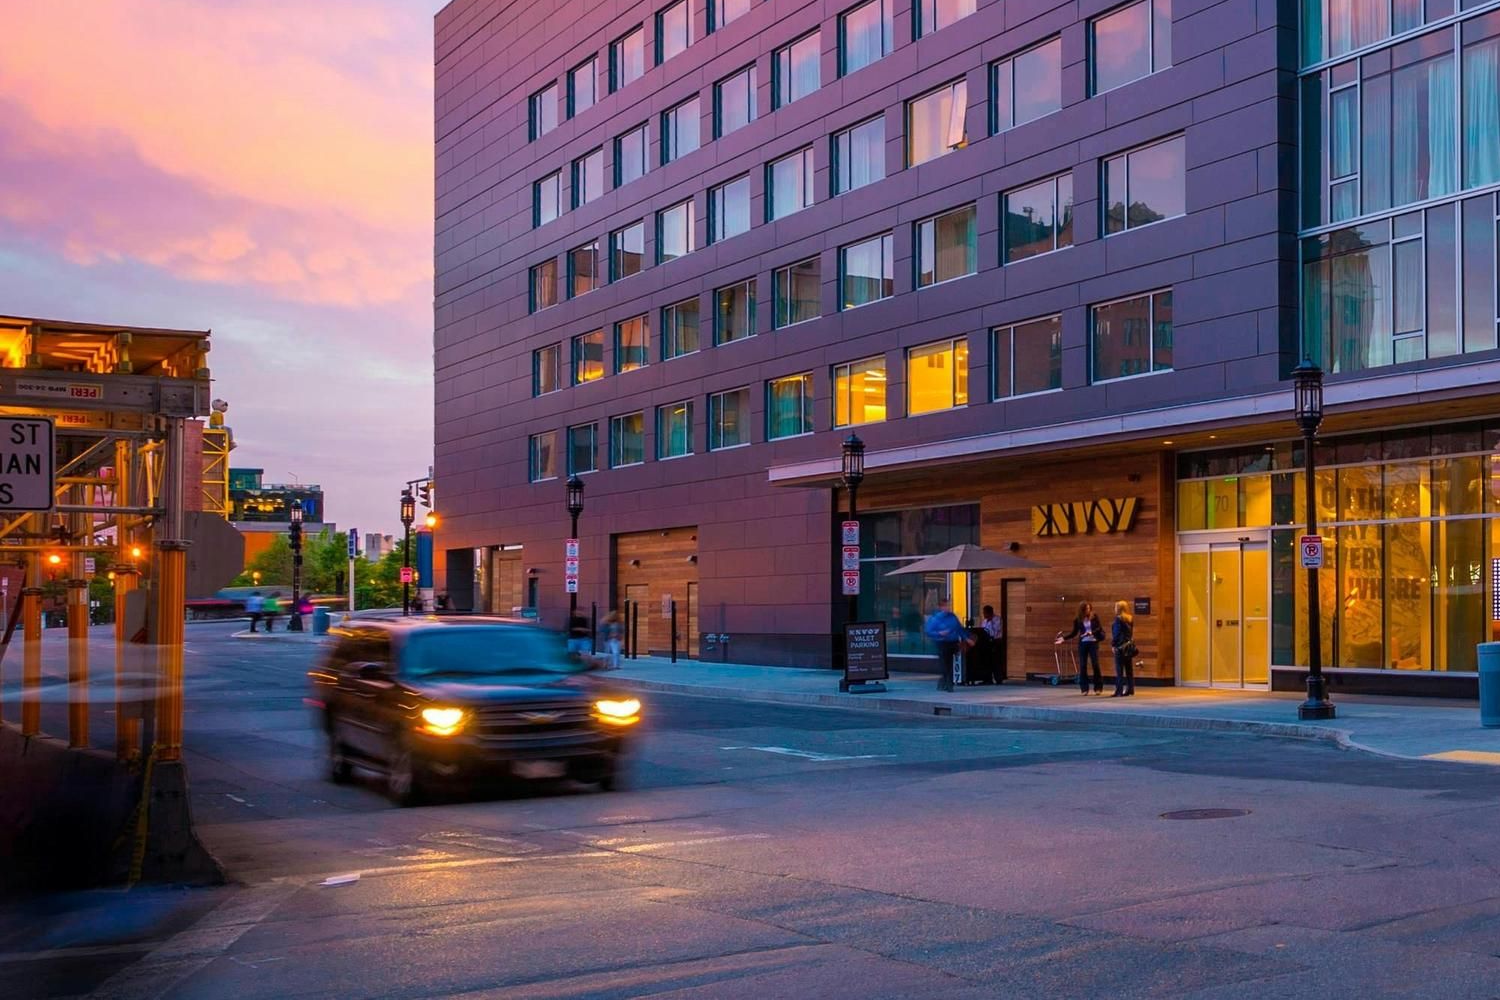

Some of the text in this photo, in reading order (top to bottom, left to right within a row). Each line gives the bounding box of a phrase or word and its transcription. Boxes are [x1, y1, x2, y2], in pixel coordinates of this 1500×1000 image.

[70, 387, 97, 398] PERI
[63, 415, 86, 424] PERI
[11, 423, 41, 445] ST
[1215, 495, 1229, 512] 70
[1032, 497, 1137, 536] ENVOY
[1349, 577, 1421, 600] WHRE
[850, 640, 880, 649] PARKING
